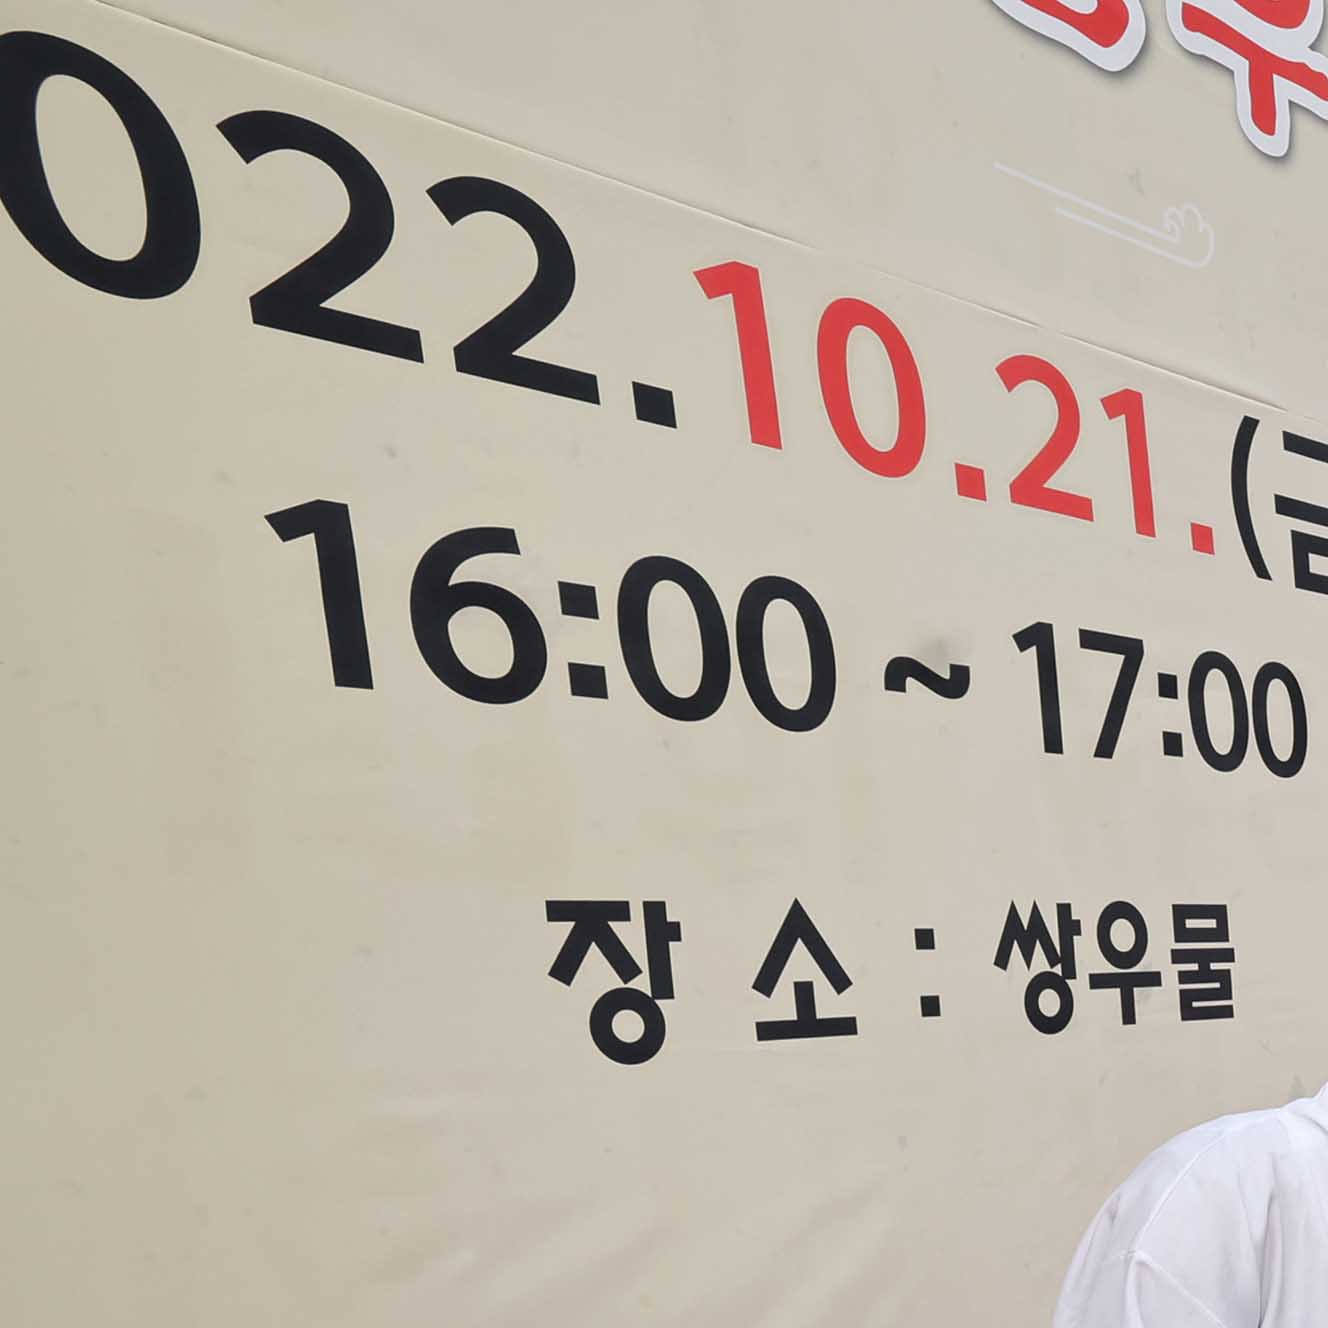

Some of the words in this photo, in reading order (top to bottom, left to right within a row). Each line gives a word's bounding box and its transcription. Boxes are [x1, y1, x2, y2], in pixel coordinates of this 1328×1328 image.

[264, 500, 836, 732] 16:00
[1010, 620, 1308, 779] 17:00
[993, 900, 1236, 1035] 쌍우물
